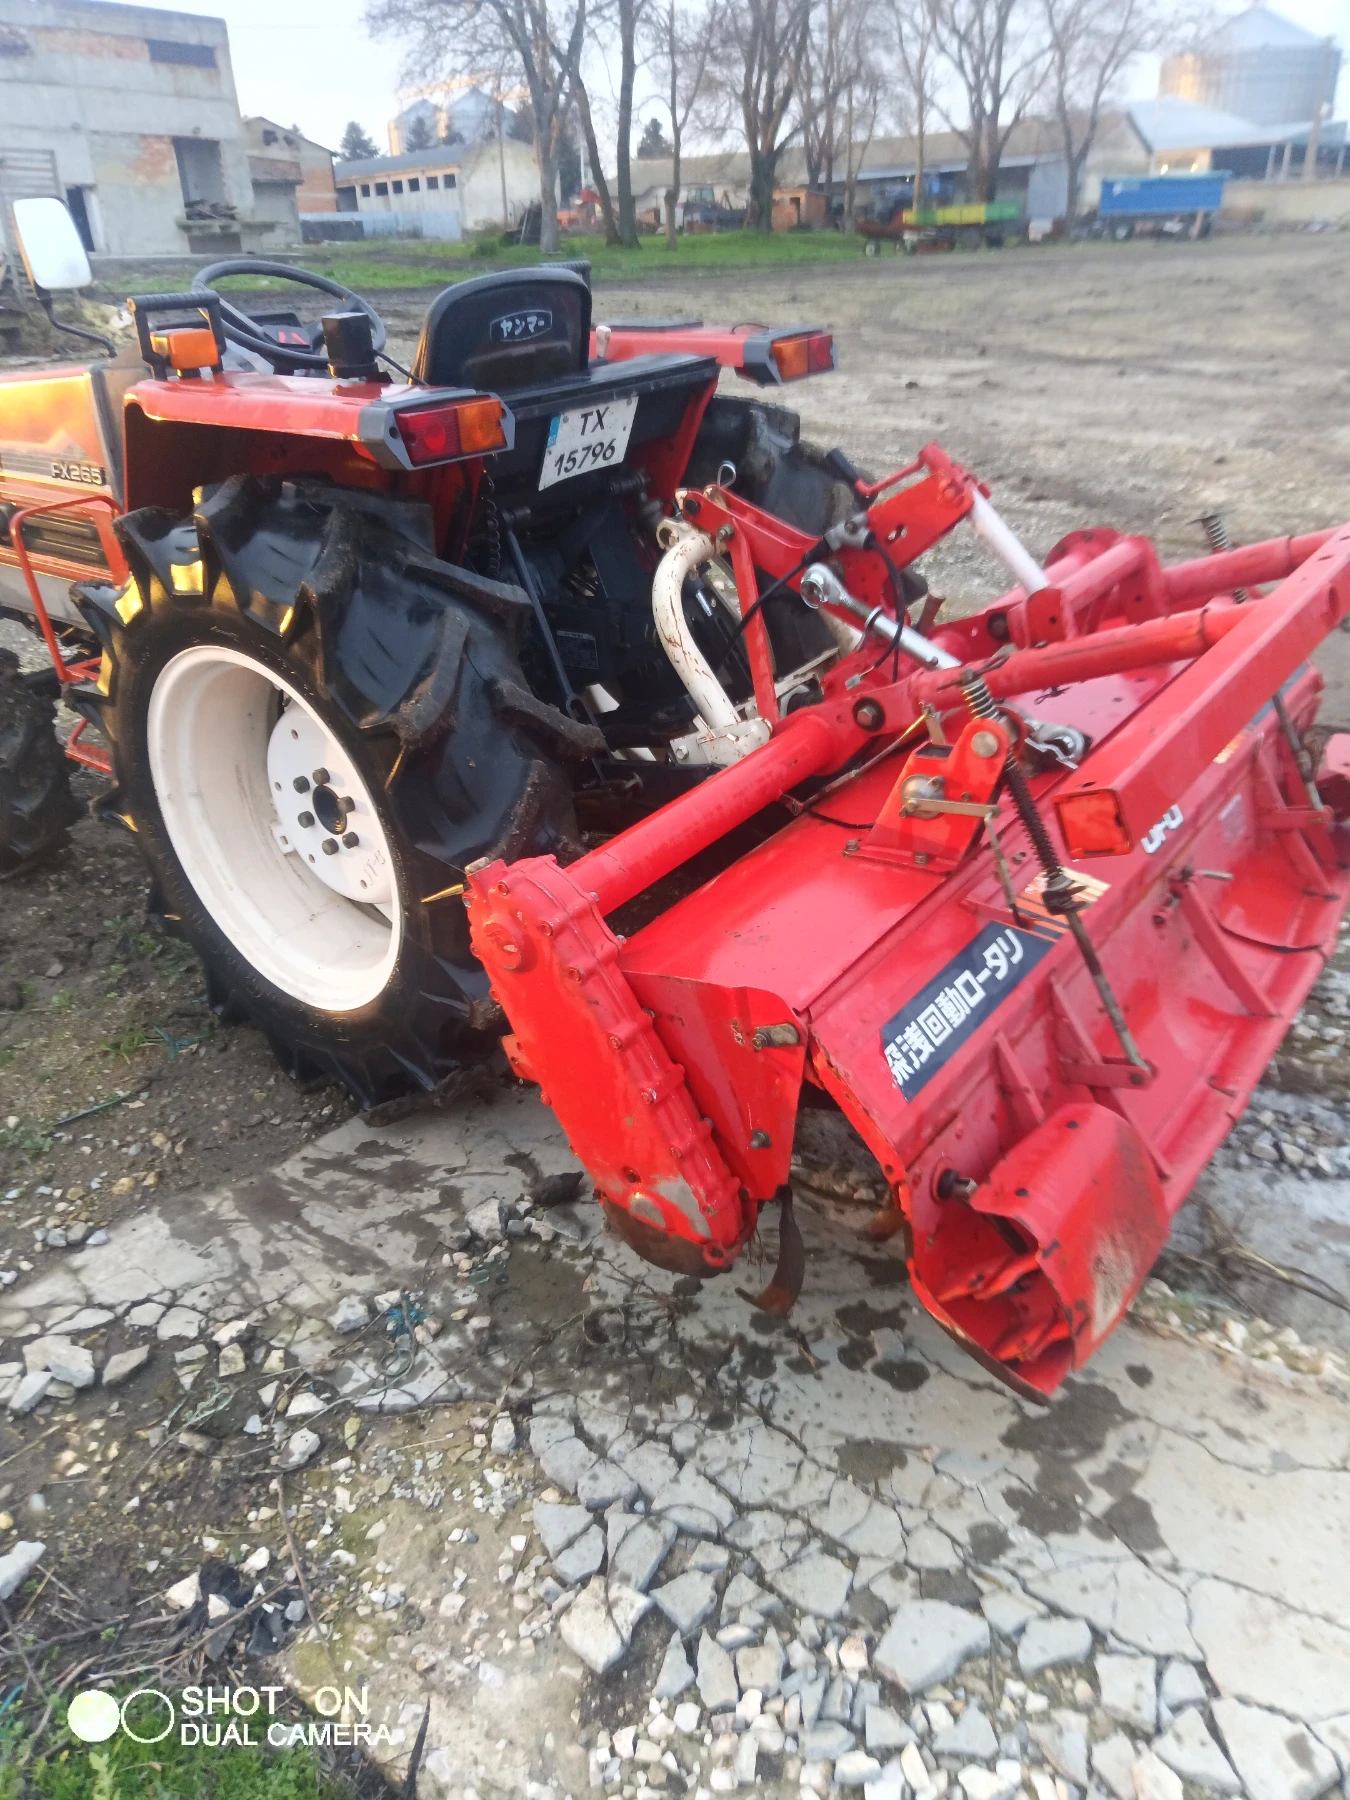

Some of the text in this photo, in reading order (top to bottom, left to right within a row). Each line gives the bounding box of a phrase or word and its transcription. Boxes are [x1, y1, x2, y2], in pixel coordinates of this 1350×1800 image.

[500, 316, 545, 338] ヤンマー
[580, 406, 610, 436] TX
[554, 438, 617, 477] 15796
[50, 461, 103, 485] FX265
